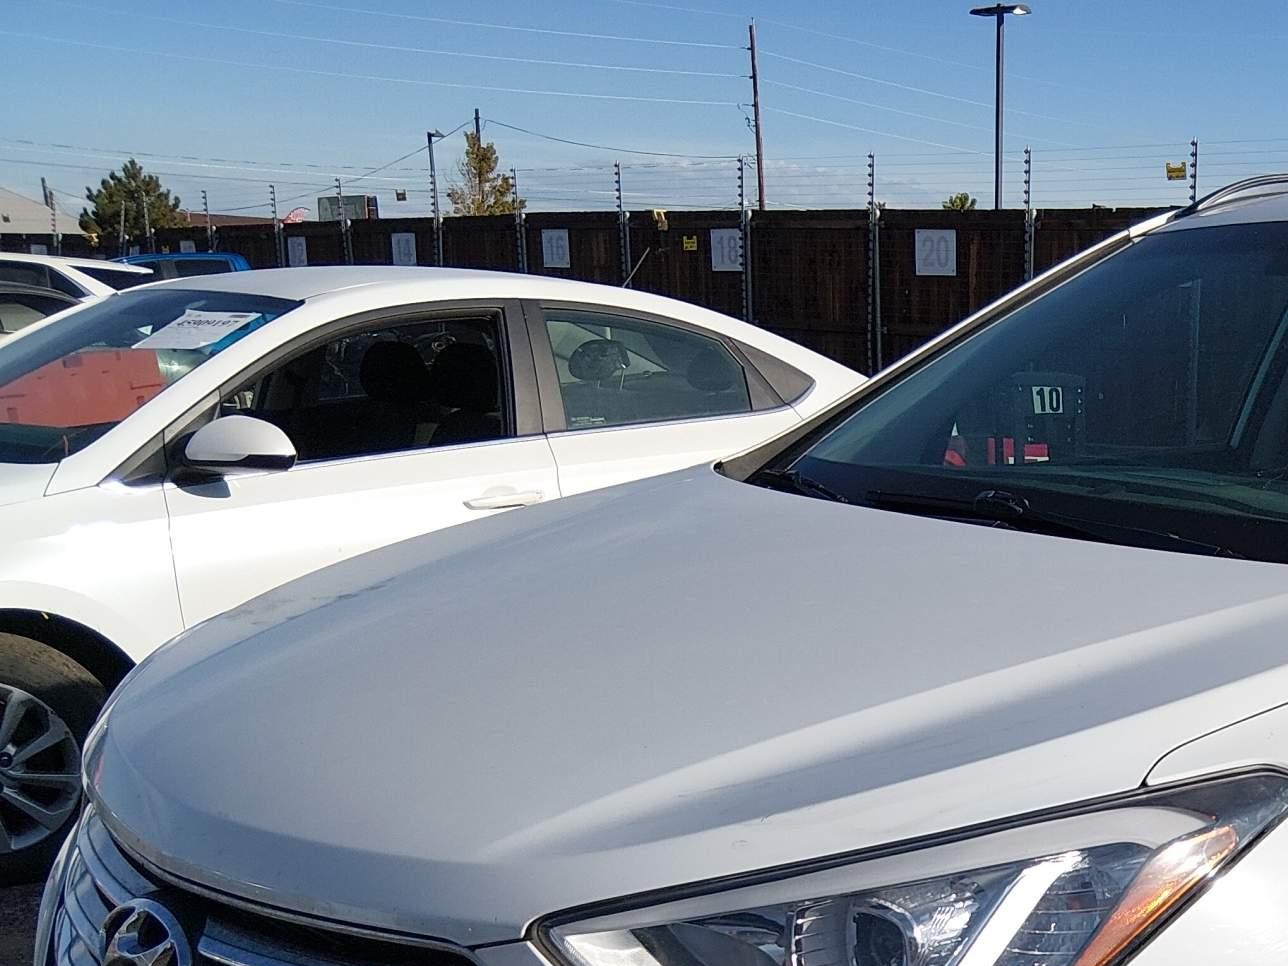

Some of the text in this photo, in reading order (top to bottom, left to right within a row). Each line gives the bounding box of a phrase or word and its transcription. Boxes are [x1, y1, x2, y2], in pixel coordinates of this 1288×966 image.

[547, 235, 566, 262] 16
[716, 235, 738, 265] 18
[921, 235, 949, 268] 20
[1035, 387, 1061, 412] 10
